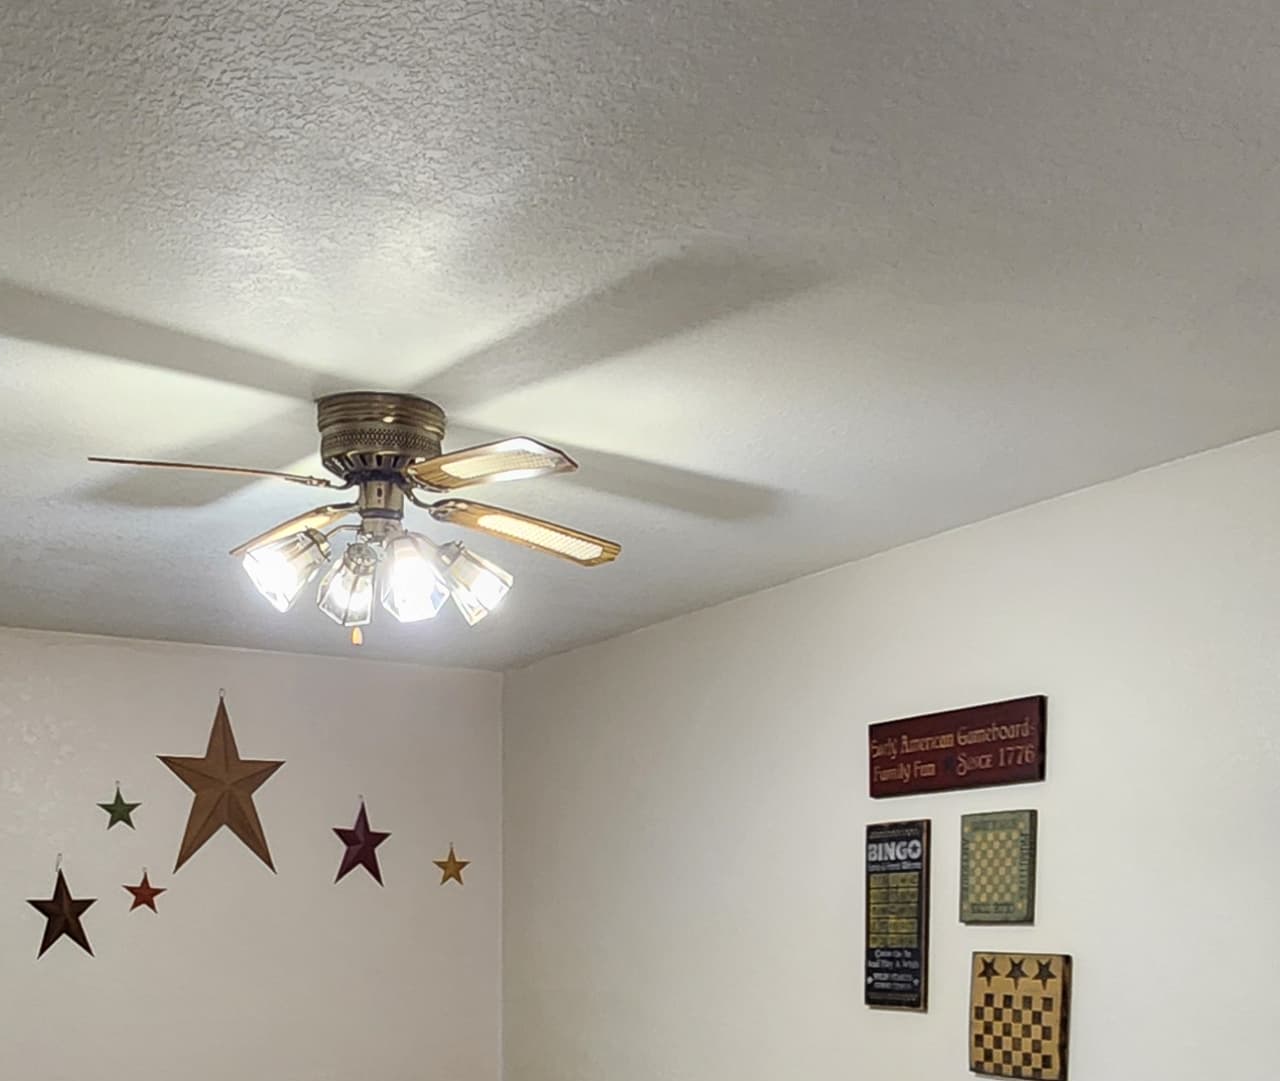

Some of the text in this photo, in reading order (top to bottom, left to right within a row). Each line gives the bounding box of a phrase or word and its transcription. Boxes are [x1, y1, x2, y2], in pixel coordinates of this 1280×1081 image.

[900, 733, 955, 754] American
[873, 745, 1036, 784] Family Fun Since 1776
[867, 839, 922, 862] BINGO
